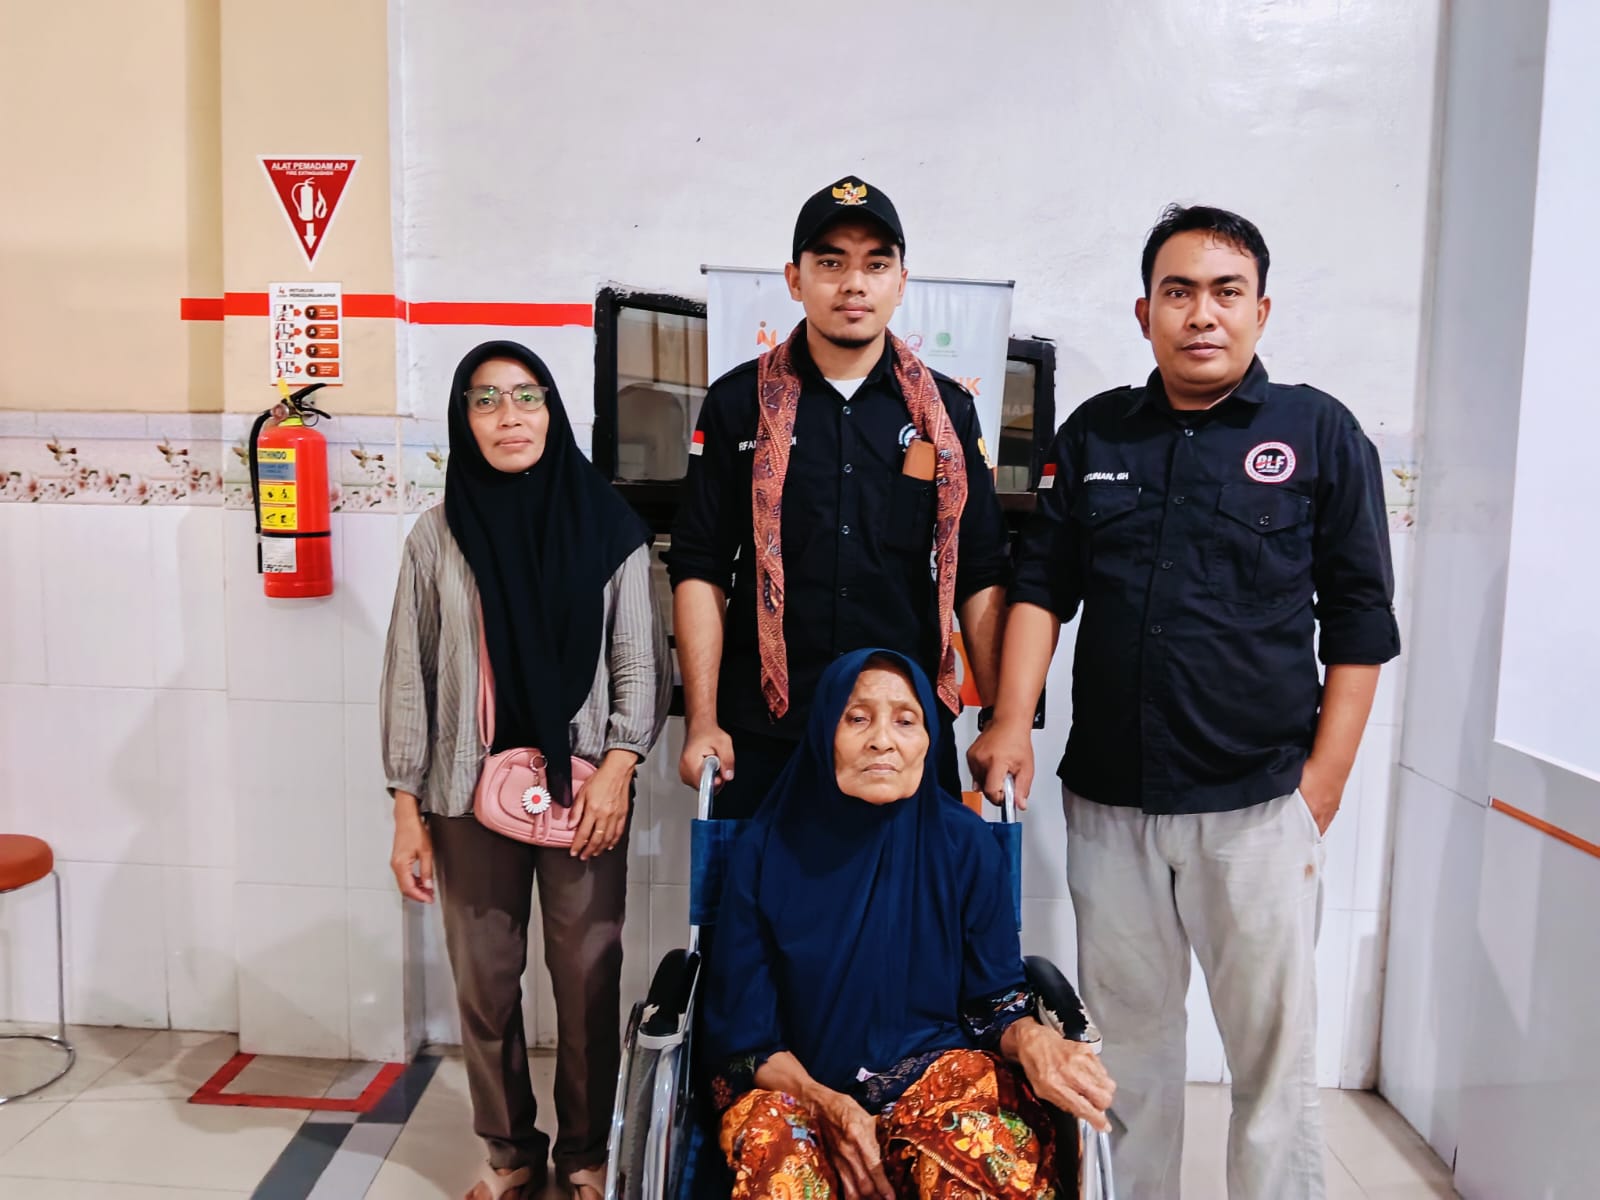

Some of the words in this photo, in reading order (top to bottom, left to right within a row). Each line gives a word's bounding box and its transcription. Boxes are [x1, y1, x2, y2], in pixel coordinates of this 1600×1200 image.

[271, 162, 292, 170] ALAT
[292, 162, 334, 170] PEMADAM
[334, 162, 349, 170] API
